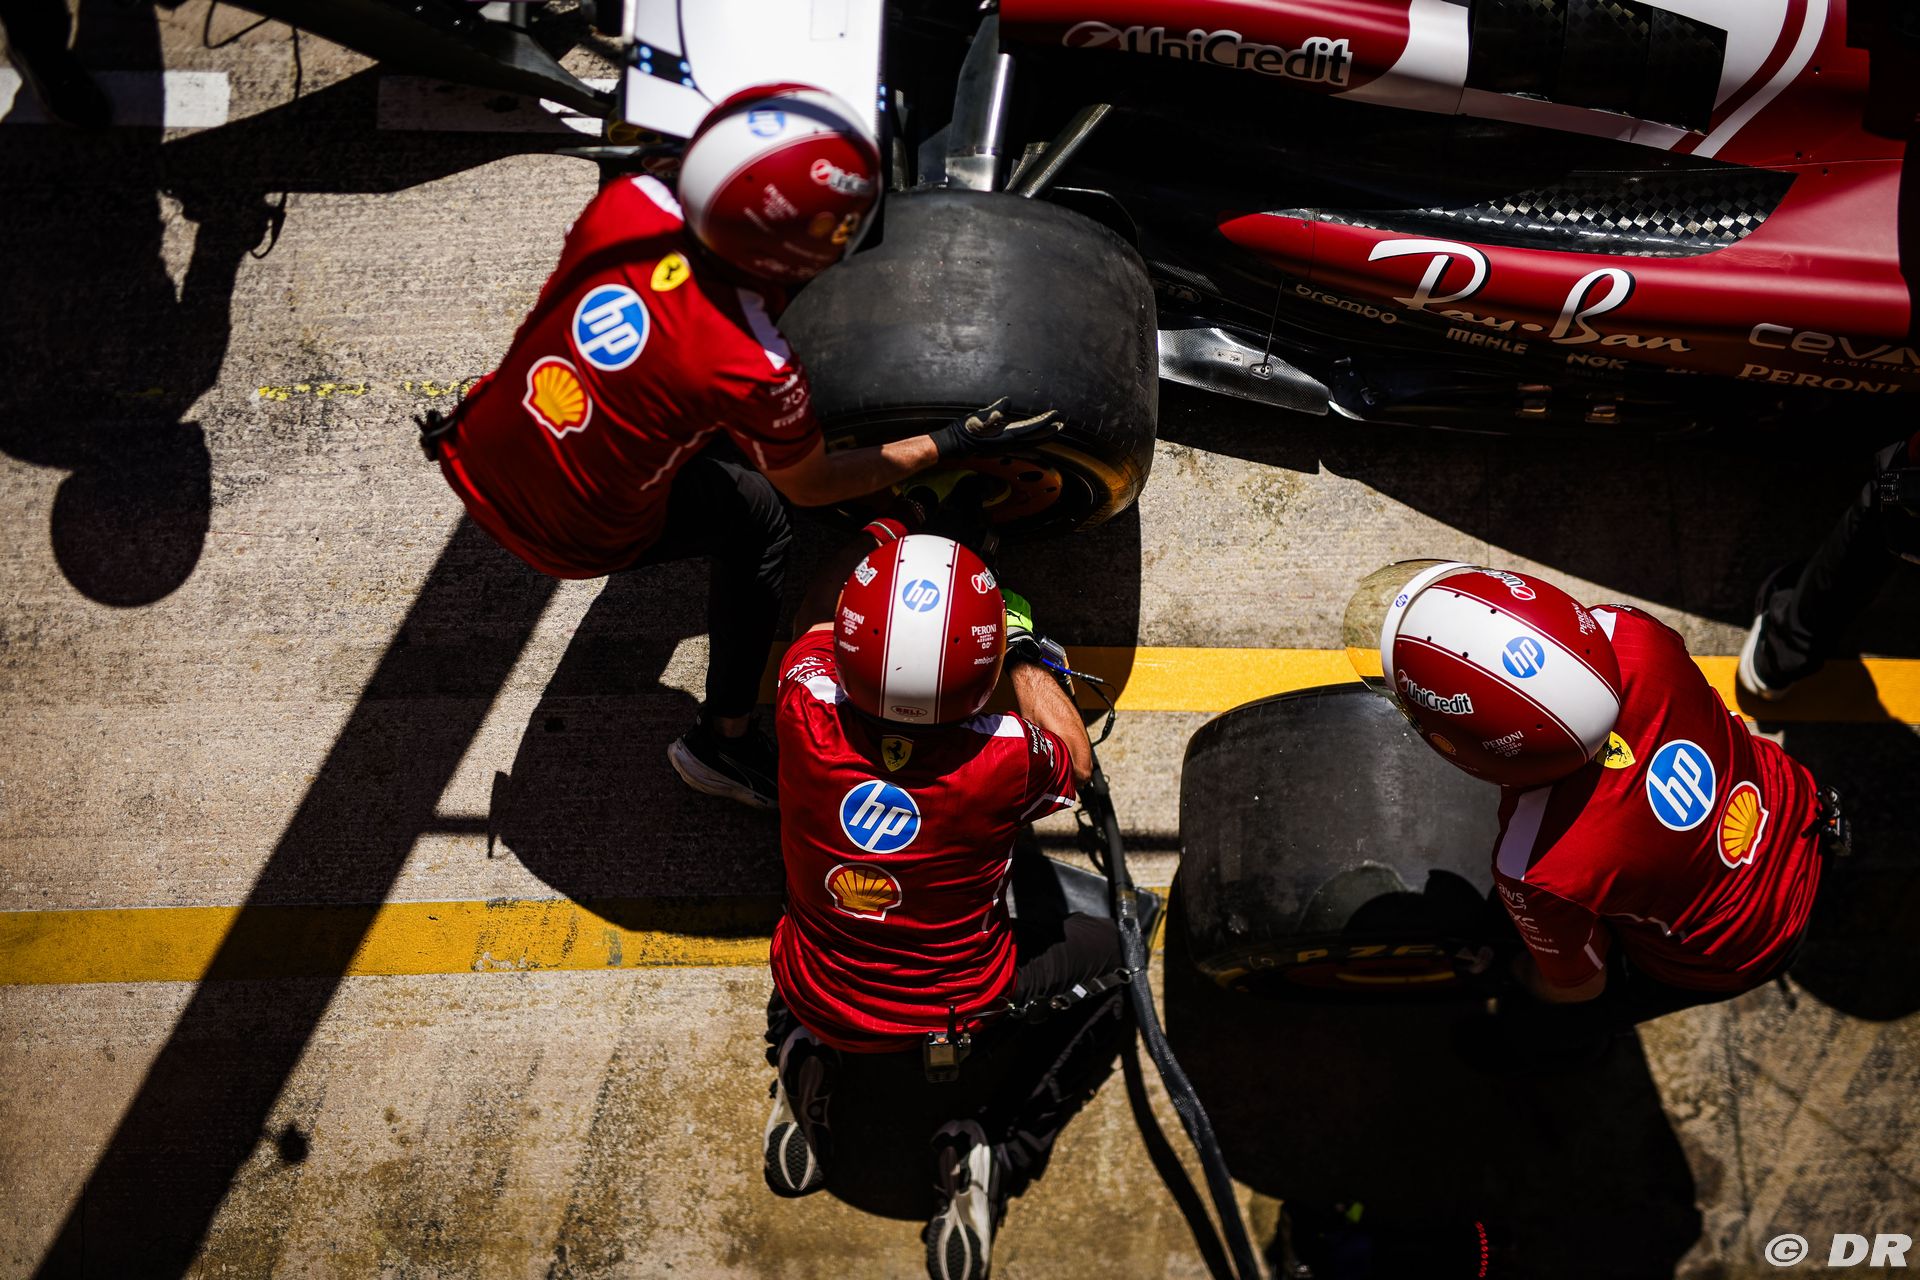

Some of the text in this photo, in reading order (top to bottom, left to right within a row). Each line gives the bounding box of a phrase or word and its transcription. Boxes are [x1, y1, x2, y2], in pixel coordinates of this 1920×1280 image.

[1296, 284, 1398, 324] brembo
[579, 290, 642, 359] hp
[1447, 327, 1529, 355] MAHLE
[1566, 352, 1630, 371] NGK
[1734, 363, 1902, 393] PERONI
[903, 578, 940, 613] hp
[971, 623, 997, 636] PERONI
[1503, 638, 1541, 678] hp
[1405, 679, 1474, 714] UniCredit
[1481, 730, 1525, 751] PERONI
[1648, 746, 1713, 823] hp
[848, 780, 913, 851] hp
